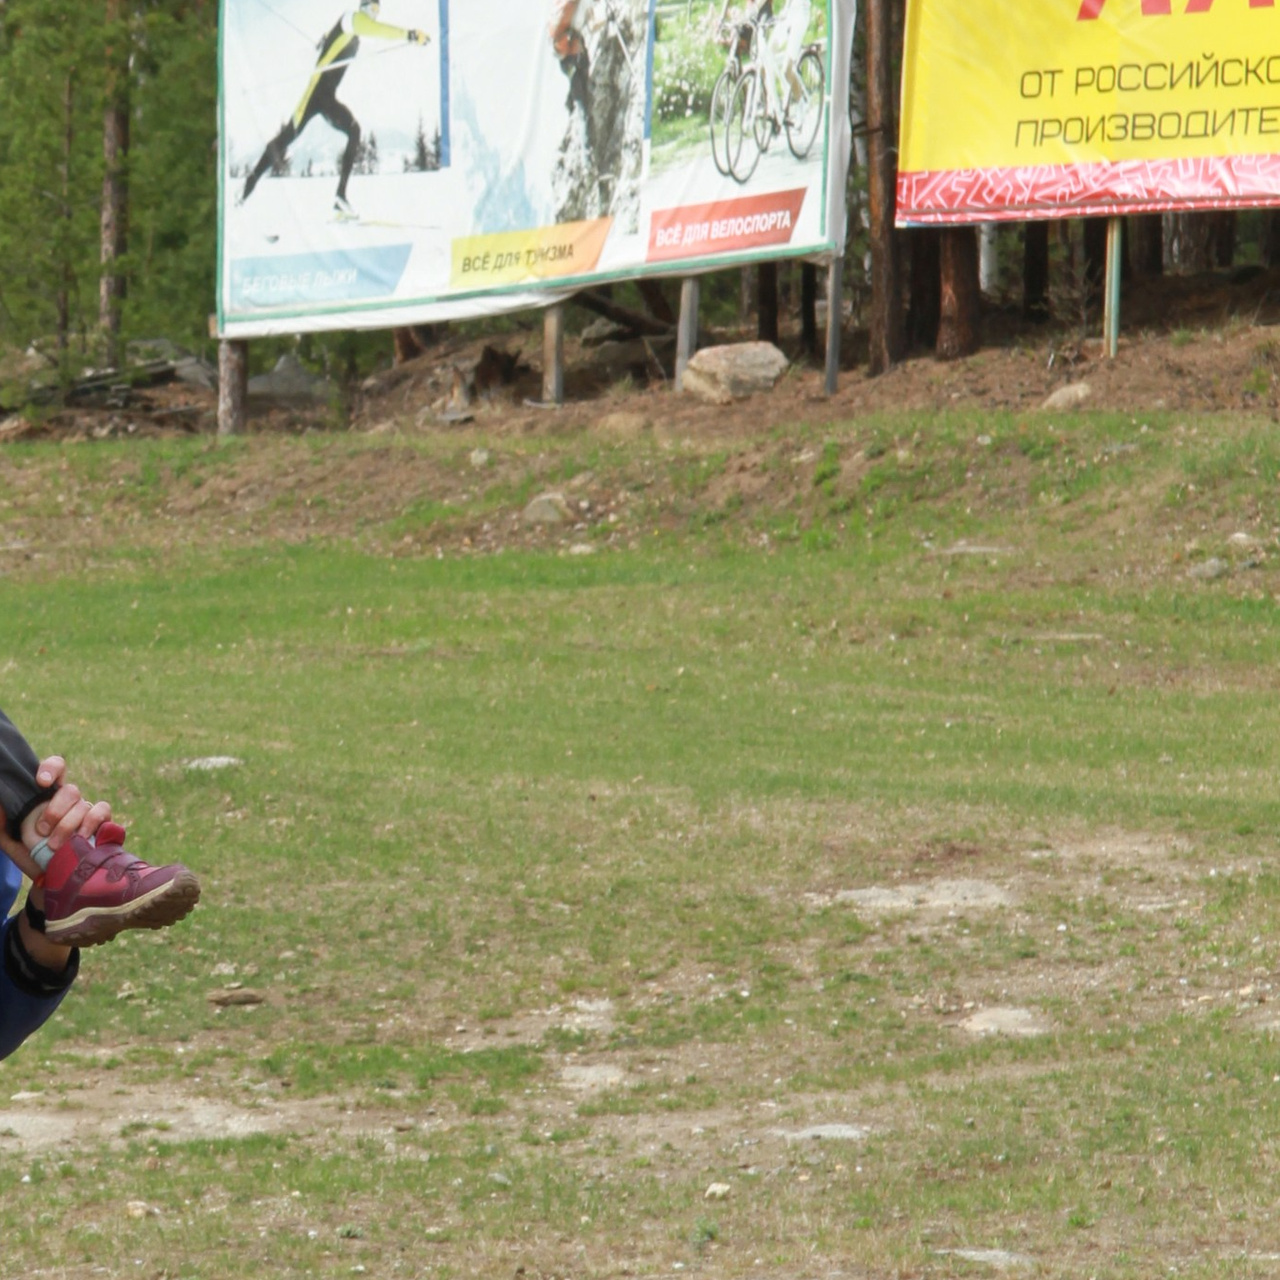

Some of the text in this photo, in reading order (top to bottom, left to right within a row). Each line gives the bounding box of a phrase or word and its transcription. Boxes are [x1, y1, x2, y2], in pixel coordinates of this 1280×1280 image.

[1020, 70, 1064, 99] ОТ
[1015, 106, 1280, 148] ПРОИЗВОДИТЕ
[656, 210, 792, 247] ВСЁ ДЛЯ ВЕЛОСПОРТА
[462, 251, 491, 273] ВСЁ
[492, 251, 522, 274] ДЛЯ
